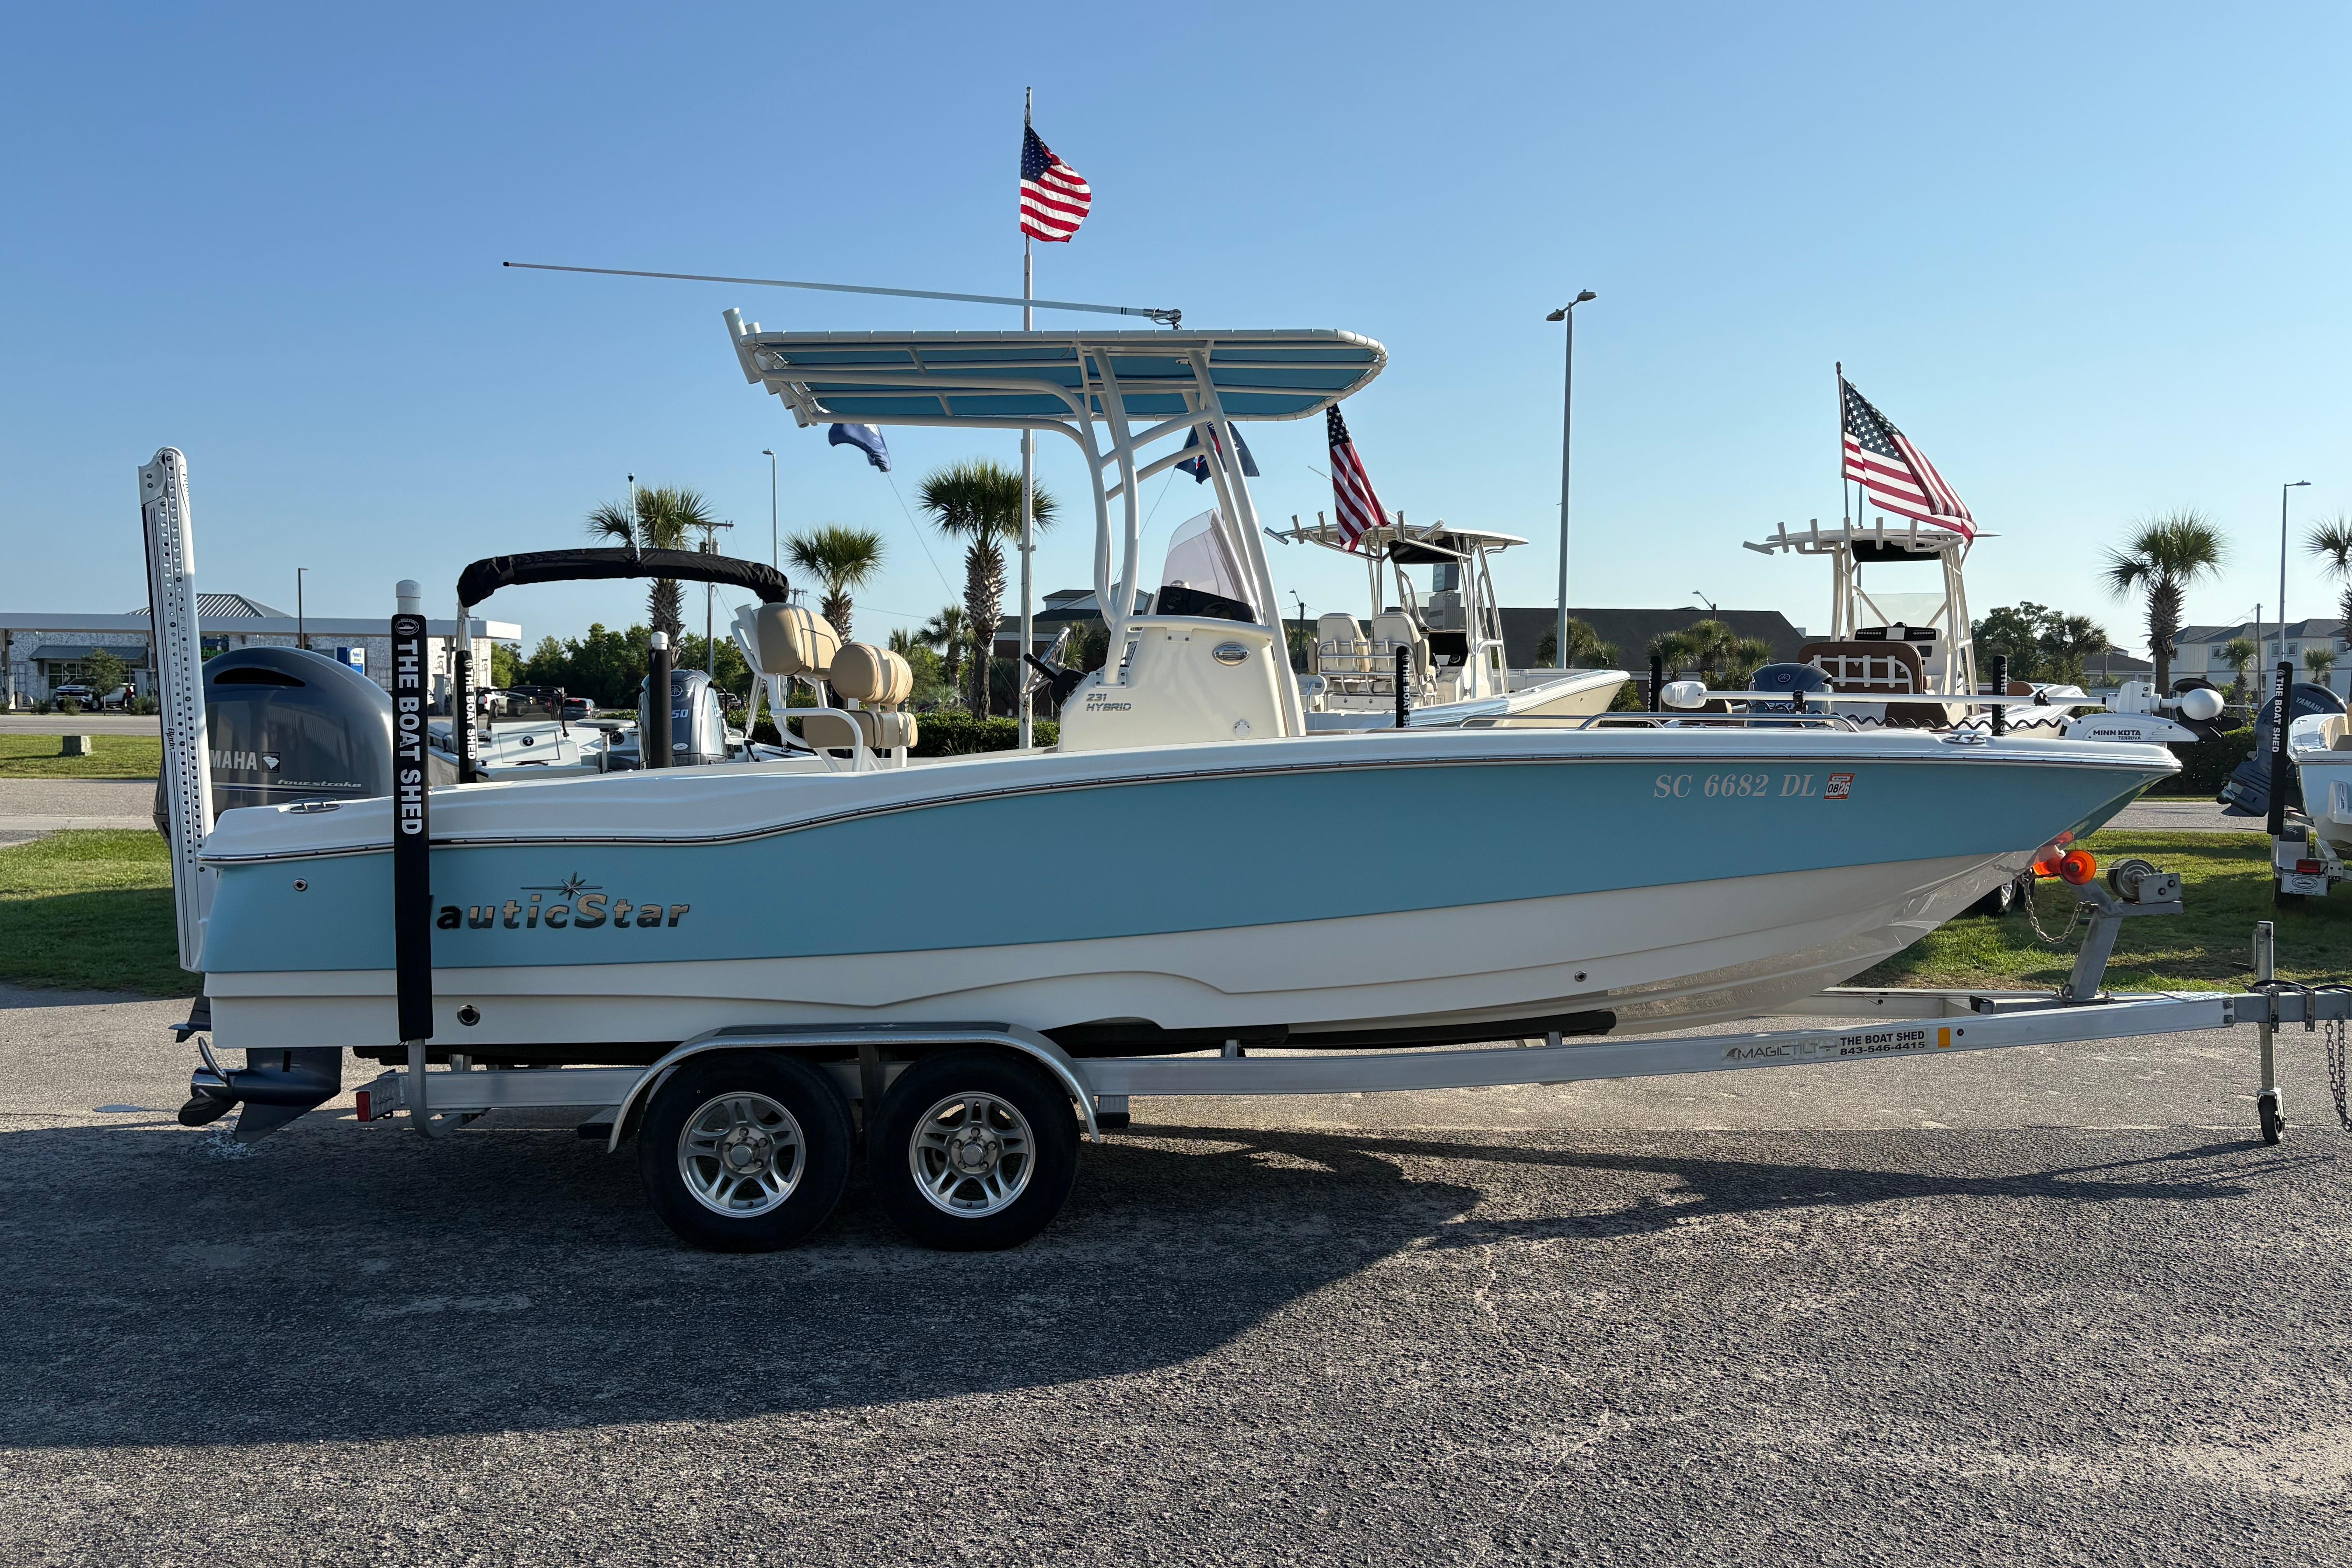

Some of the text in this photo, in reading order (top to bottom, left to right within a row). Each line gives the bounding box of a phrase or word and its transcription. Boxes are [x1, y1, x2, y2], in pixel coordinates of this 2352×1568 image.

[398, 639, 419, 688] THE
[1086, 693, 1107, 702] 231
[1086, 703, 1132, 711] HYBRID
[2296, 696, 2324, 713] YAMAHA
[465, 669, 476, 759] THE BOAT SHED
[2272, 677, 2284, 753] THE BOAT SHED
[399, 697, 420, 761] BOAT
[1654, 774, 1817, 797] SC 6682 DL
[1828, 782, 1850, 795] 08 26
[400, 769, 422, 834] SHED
[431, 894, 690, 929] auticStar
[1840, 1031, 1924, 1046] THE BOAT SHED
[1840, 1042, 1925, 1055] 843-546-4415
